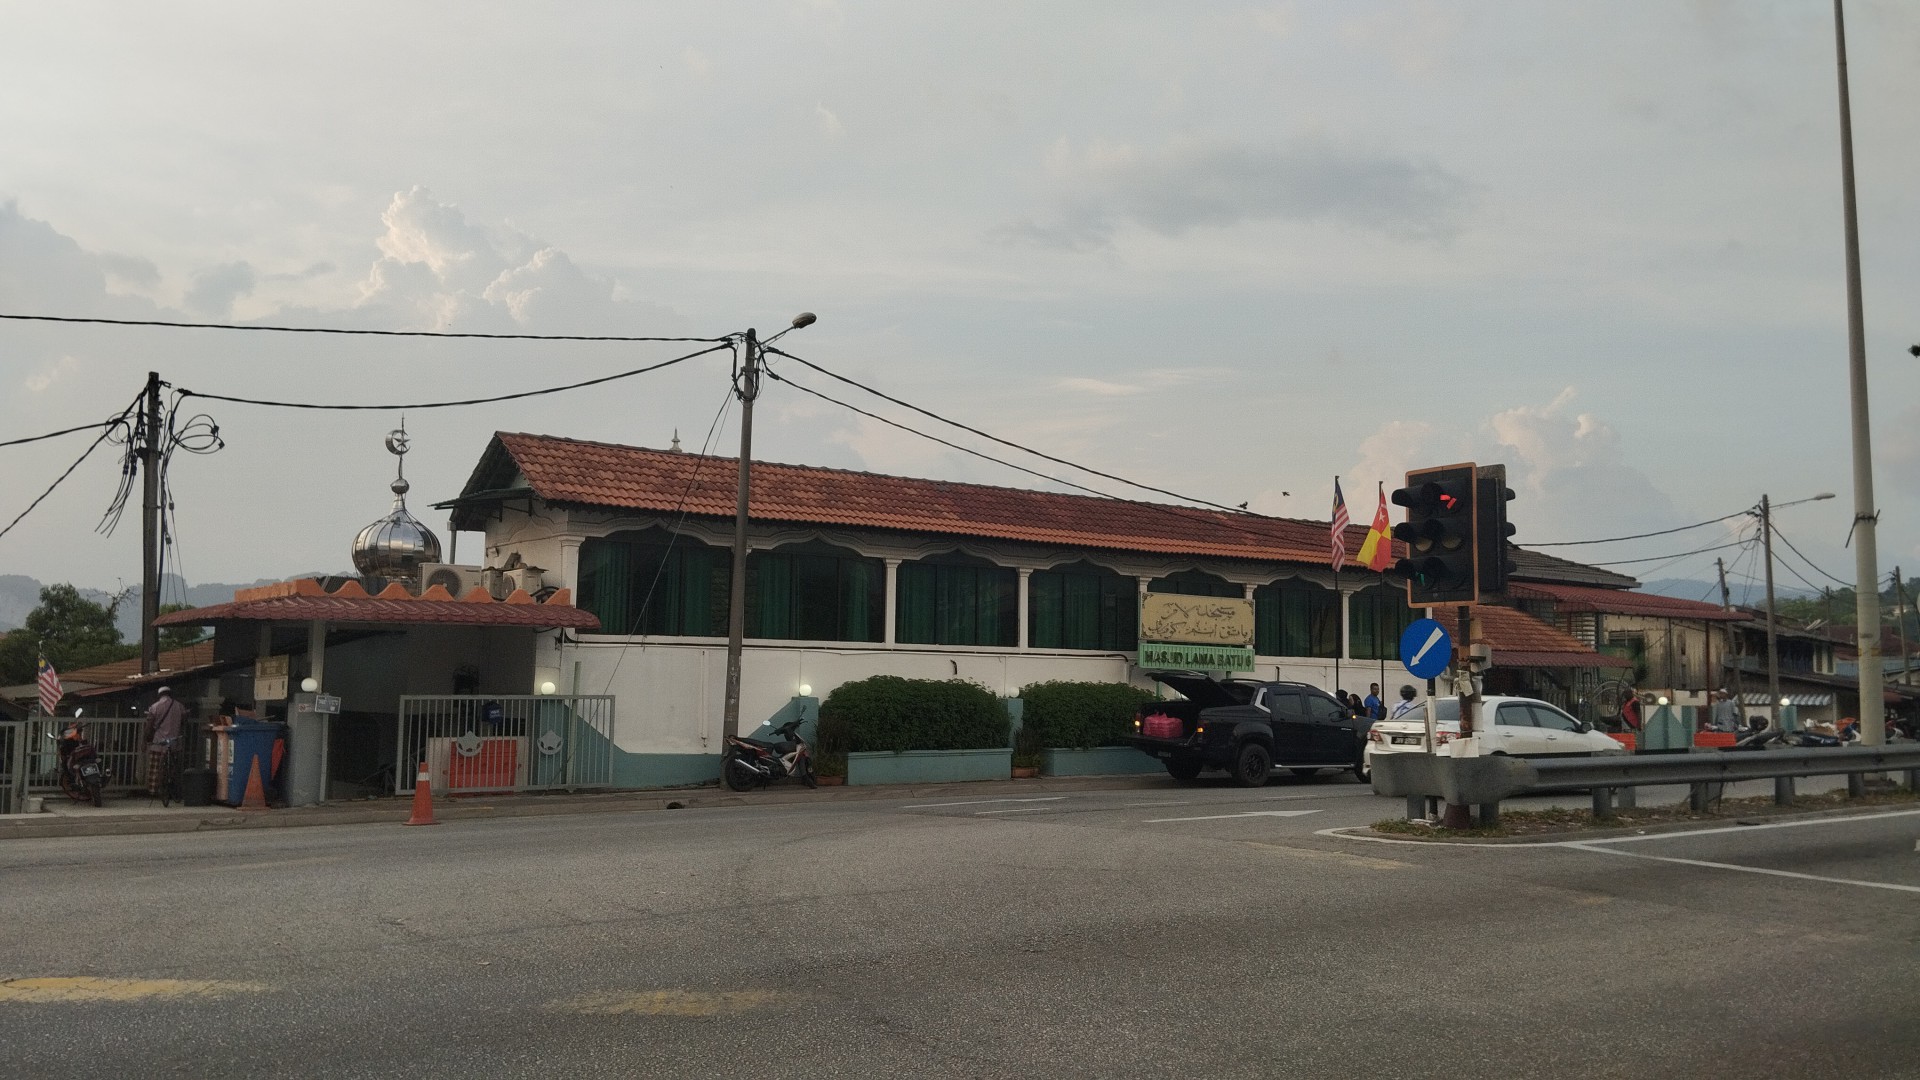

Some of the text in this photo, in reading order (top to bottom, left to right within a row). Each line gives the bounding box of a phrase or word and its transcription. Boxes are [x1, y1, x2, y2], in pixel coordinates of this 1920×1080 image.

[1144, 650, 1183, 665] MASJID
[1185, 652, 1215, 666] LAMA
[1217, 654, 1244, 667] BATU
